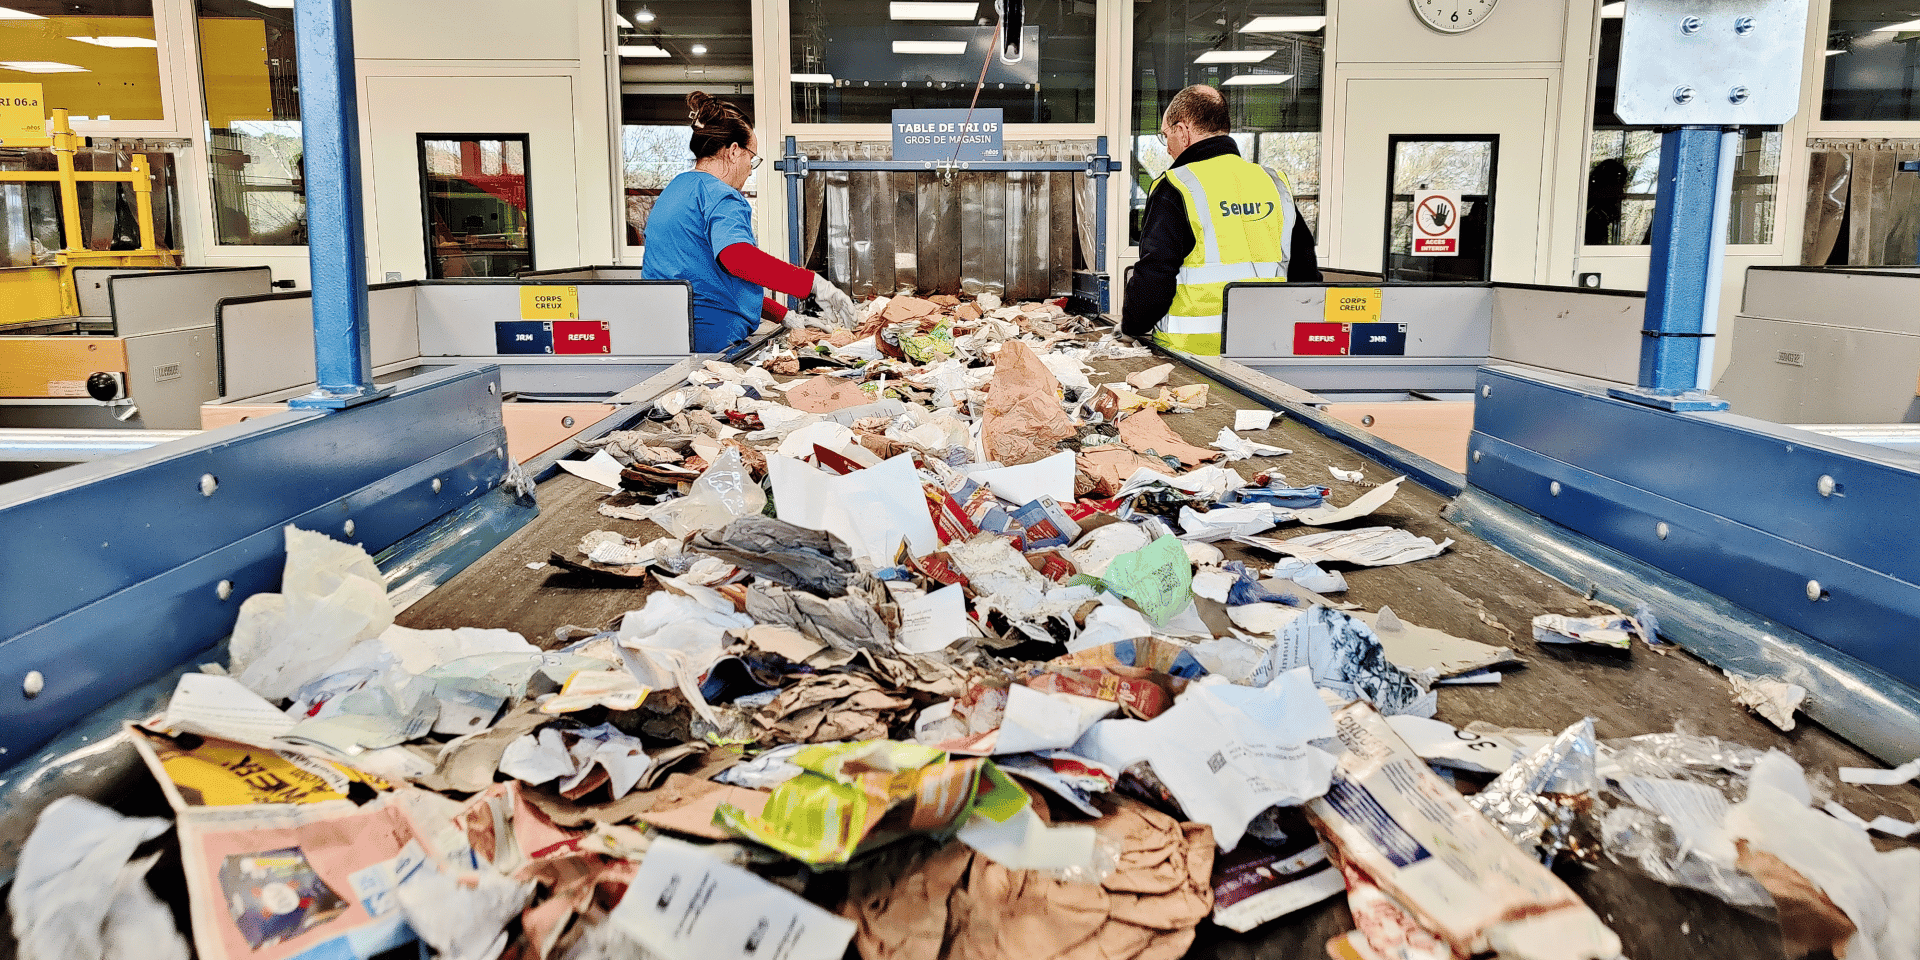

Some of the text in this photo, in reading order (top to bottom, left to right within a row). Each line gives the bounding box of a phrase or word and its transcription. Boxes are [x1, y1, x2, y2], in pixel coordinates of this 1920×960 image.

[1450, 11, 1459, 22] 6
[14, 98, 38, 107] 06.a
[898, 122, 998, 133] TABLE DE TRI 05
[904, 135, 992, 144] GROS DE MAGASIN
[1219, 200, 1261, 218] Seur
[515, 333, 534, 341] JRM
[568, 333, 595, 341] REFUS
